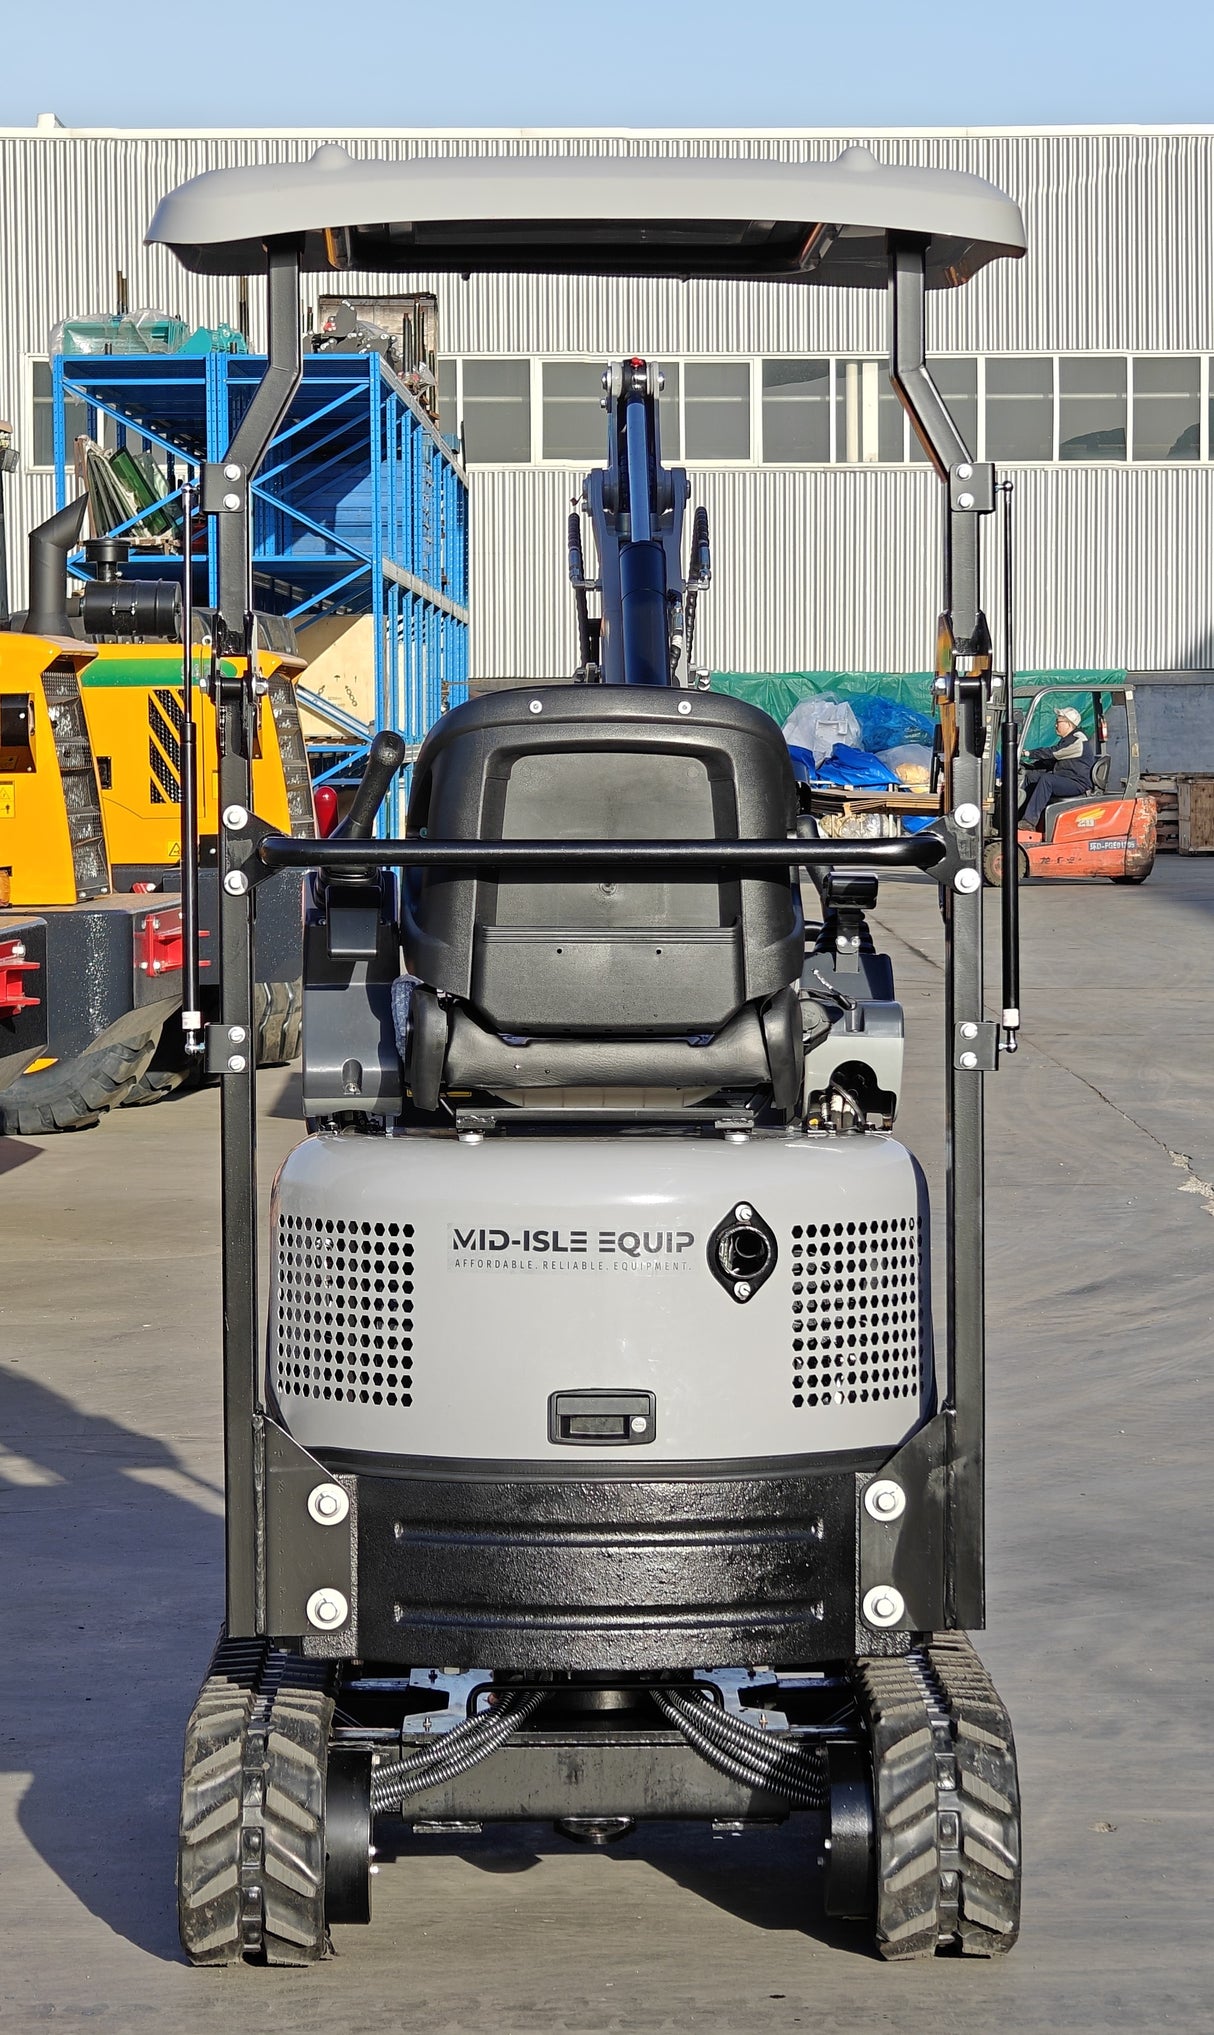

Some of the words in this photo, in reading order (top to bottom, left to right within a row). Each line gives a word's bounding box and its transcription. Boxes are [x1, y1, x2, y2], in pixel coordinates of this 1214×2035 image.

[452, 1228, 588, 1253] MID-ISLE
[598, 1231, 695, 1258] EQUIP
[454, 1259, 539, 1270] AFFORDABLE.
[542, 1260, 609, 1271] RELIABLE.
[613, 1261, 692, 1271] EQUIPMENT.
